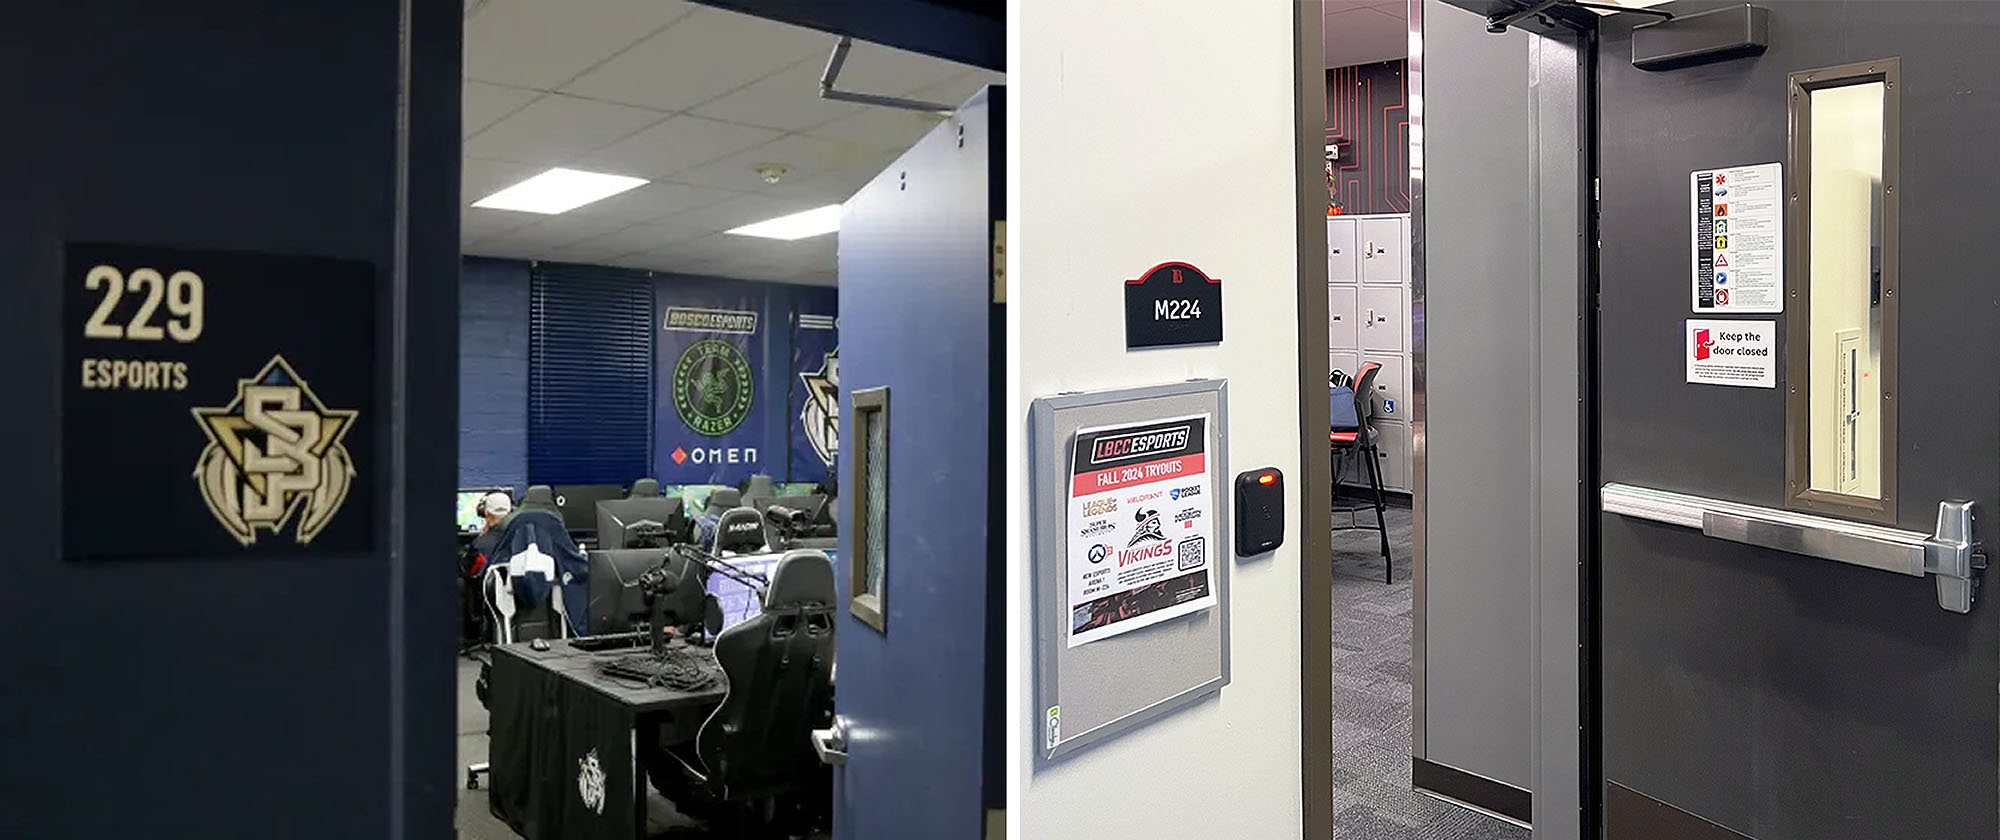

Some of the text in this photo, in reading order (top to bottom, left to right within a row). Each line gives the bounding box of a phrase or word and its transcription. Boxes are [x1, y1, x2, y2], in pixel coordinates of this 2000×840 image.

[83, 264, 205, 343] 229
[1154, 299, 1201, 320] M224
[1719, 332, 1761, 343] Keep the
[1713, 346, 1768, 357] door closed
[82, 358, 188, 391] ESPORTS
[693, 416, 732, 431] RAZER
[1097, 430, 1186, 459] LBCCESPORTS
[691, 447, 757, 464] OMEN
[1097, 460, 1182, 487] FALL 2024 TRYOUTS
[1083, 504, 1118, 518] LEGENDS
[1118, 539, 1173, 567] VIKINGS
